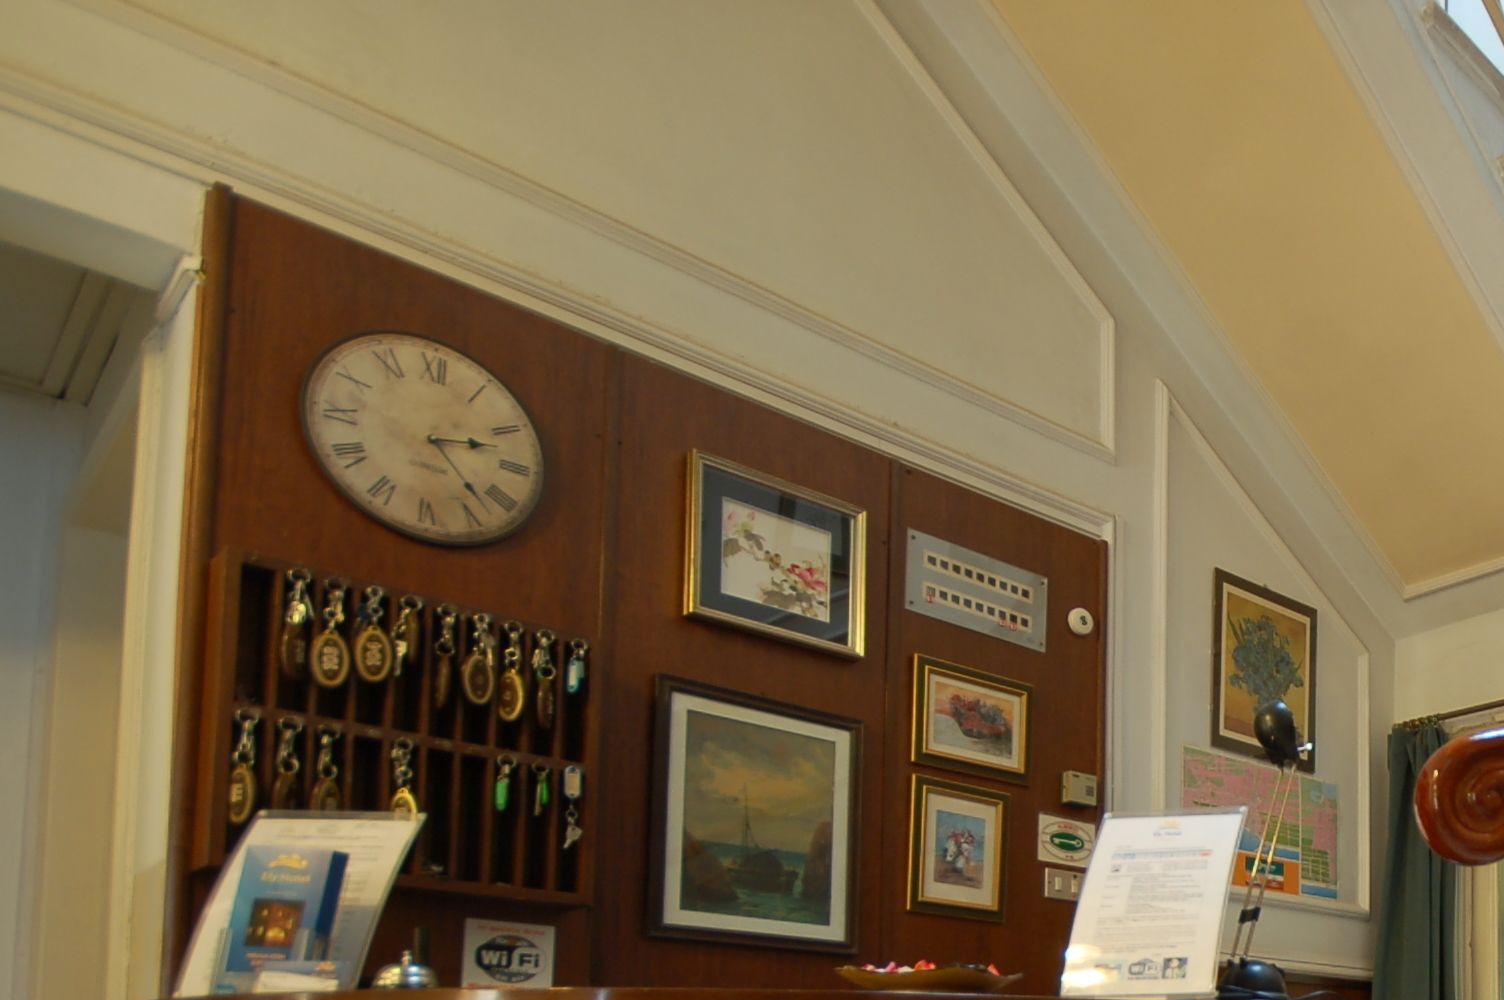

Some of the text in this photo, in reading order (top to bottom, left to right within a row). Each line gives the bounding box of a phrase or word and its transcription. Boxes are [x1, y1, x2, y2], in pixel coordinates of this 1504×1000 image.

[371, 347, 405, 379] XI
[420, 351, 447, 386] XII
[335, 364, 373, 392] X
[322, 401, 358, 426] IX
[491, 424, 521, 436] II
[499, 458, 530, 477] III
[366, 475, 397, 507] VII
